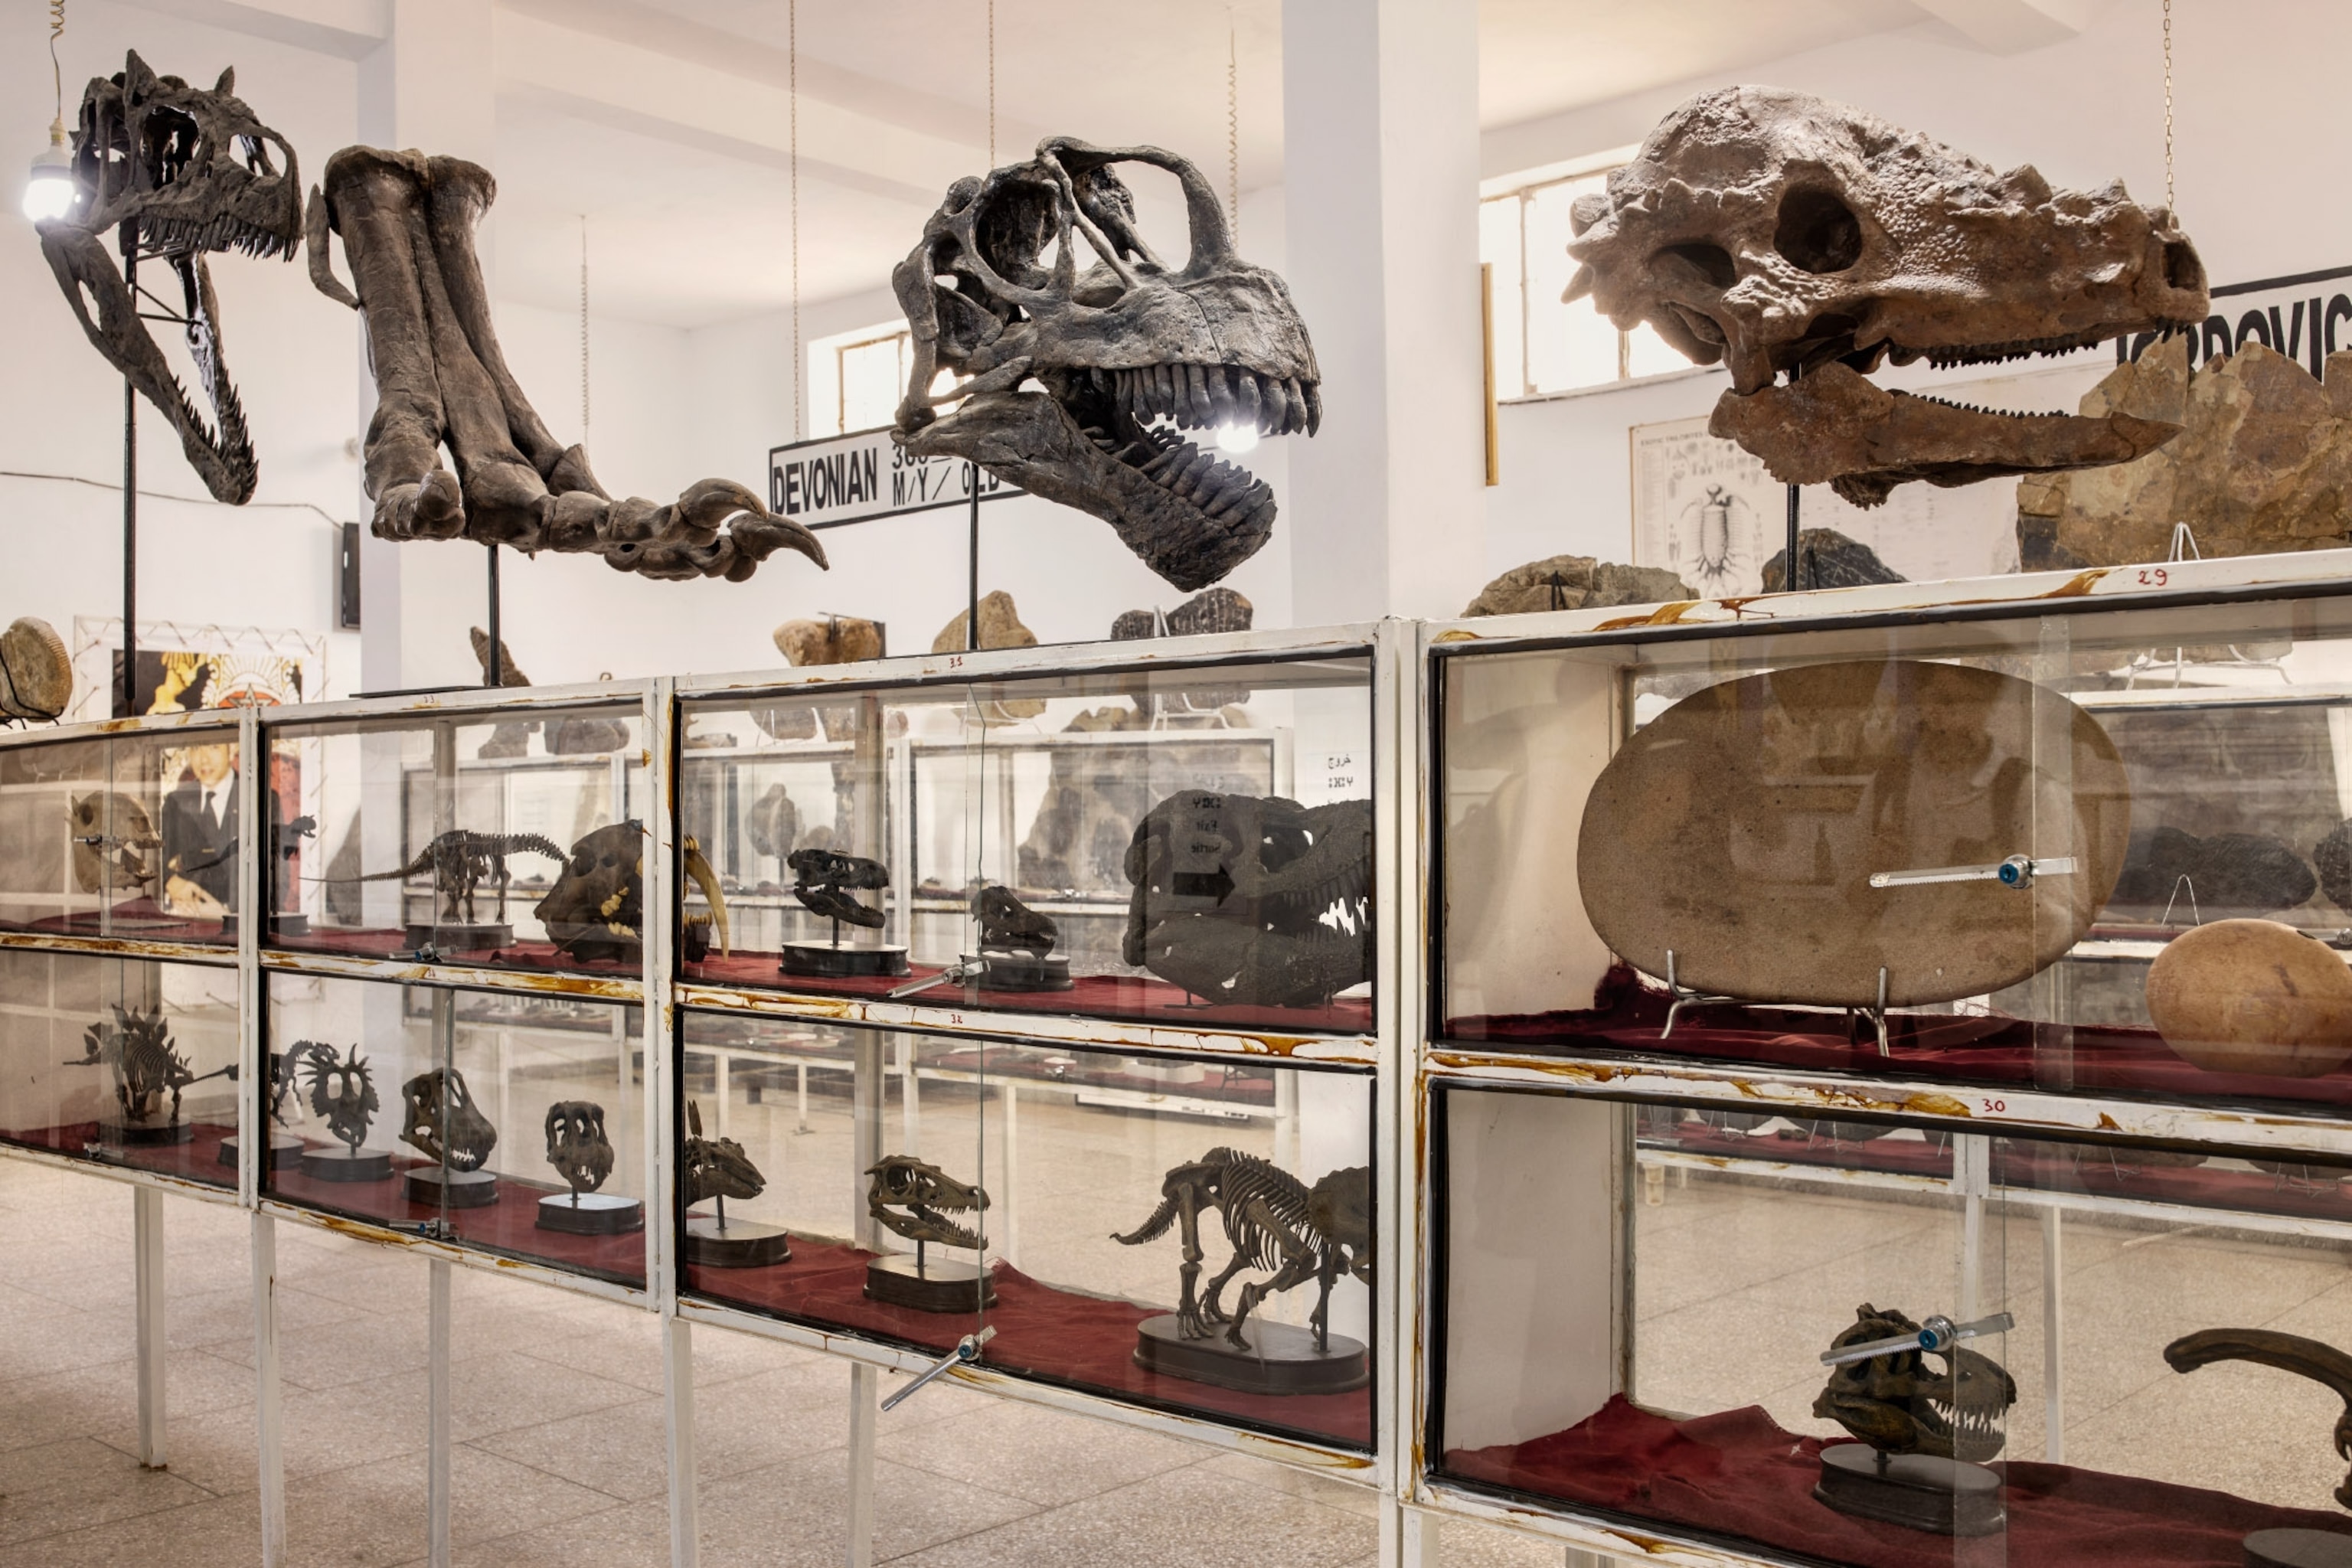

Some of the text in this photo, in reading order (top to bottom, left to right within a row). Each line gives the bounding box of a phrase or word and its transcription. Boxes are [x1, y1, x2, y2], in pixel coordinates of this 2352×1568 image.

[773, 448, 877, 514] DEVONIAN
[2138, 568, 2167, 586] 29
[1328, 753, 1351, 769] خروج
[1981, 1098, 2006, 1112] 30
